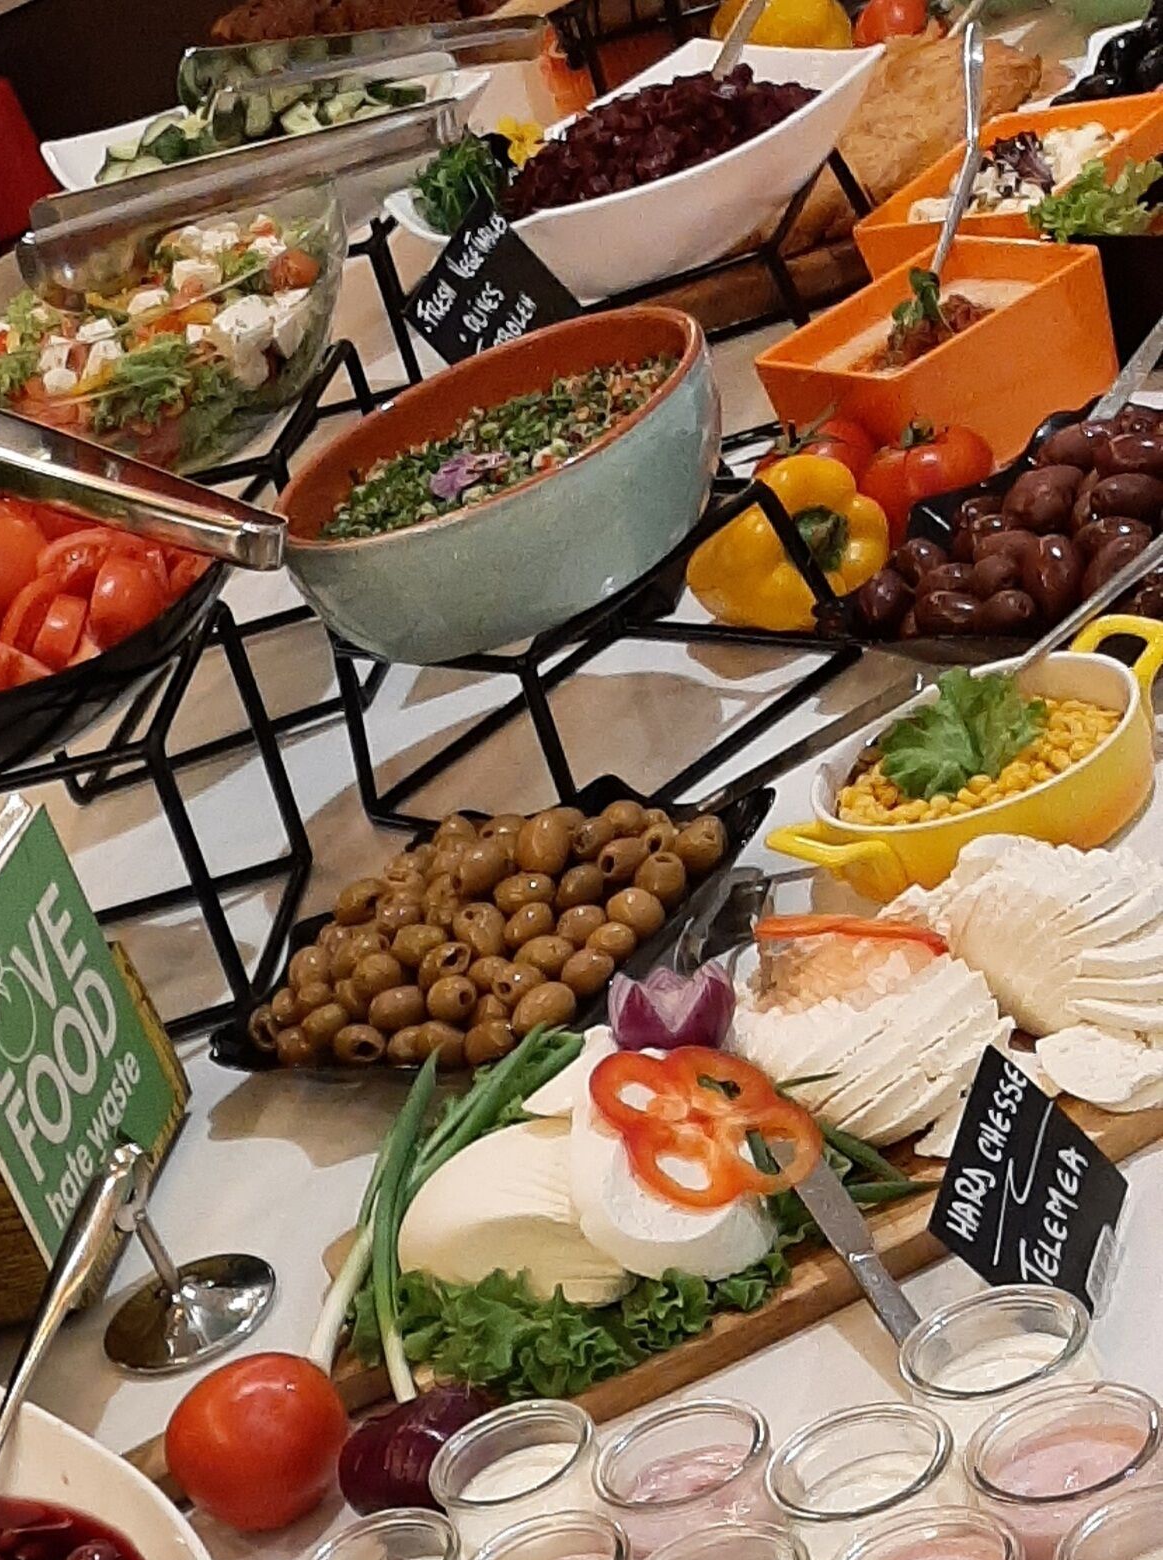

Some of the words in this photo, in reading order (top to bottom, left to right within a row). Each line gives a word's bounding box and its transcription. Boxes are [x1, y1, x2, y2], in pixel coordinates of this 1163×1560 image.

[4, 968, 117, 1184] FOOD
[44, 1144, 94, 1231] hate
[86, 1050, 141, 1146] waste
[977, 1061, 1029, 1162] CHESSE
[1019, 1146, 1090, 1285] TELEMEA
